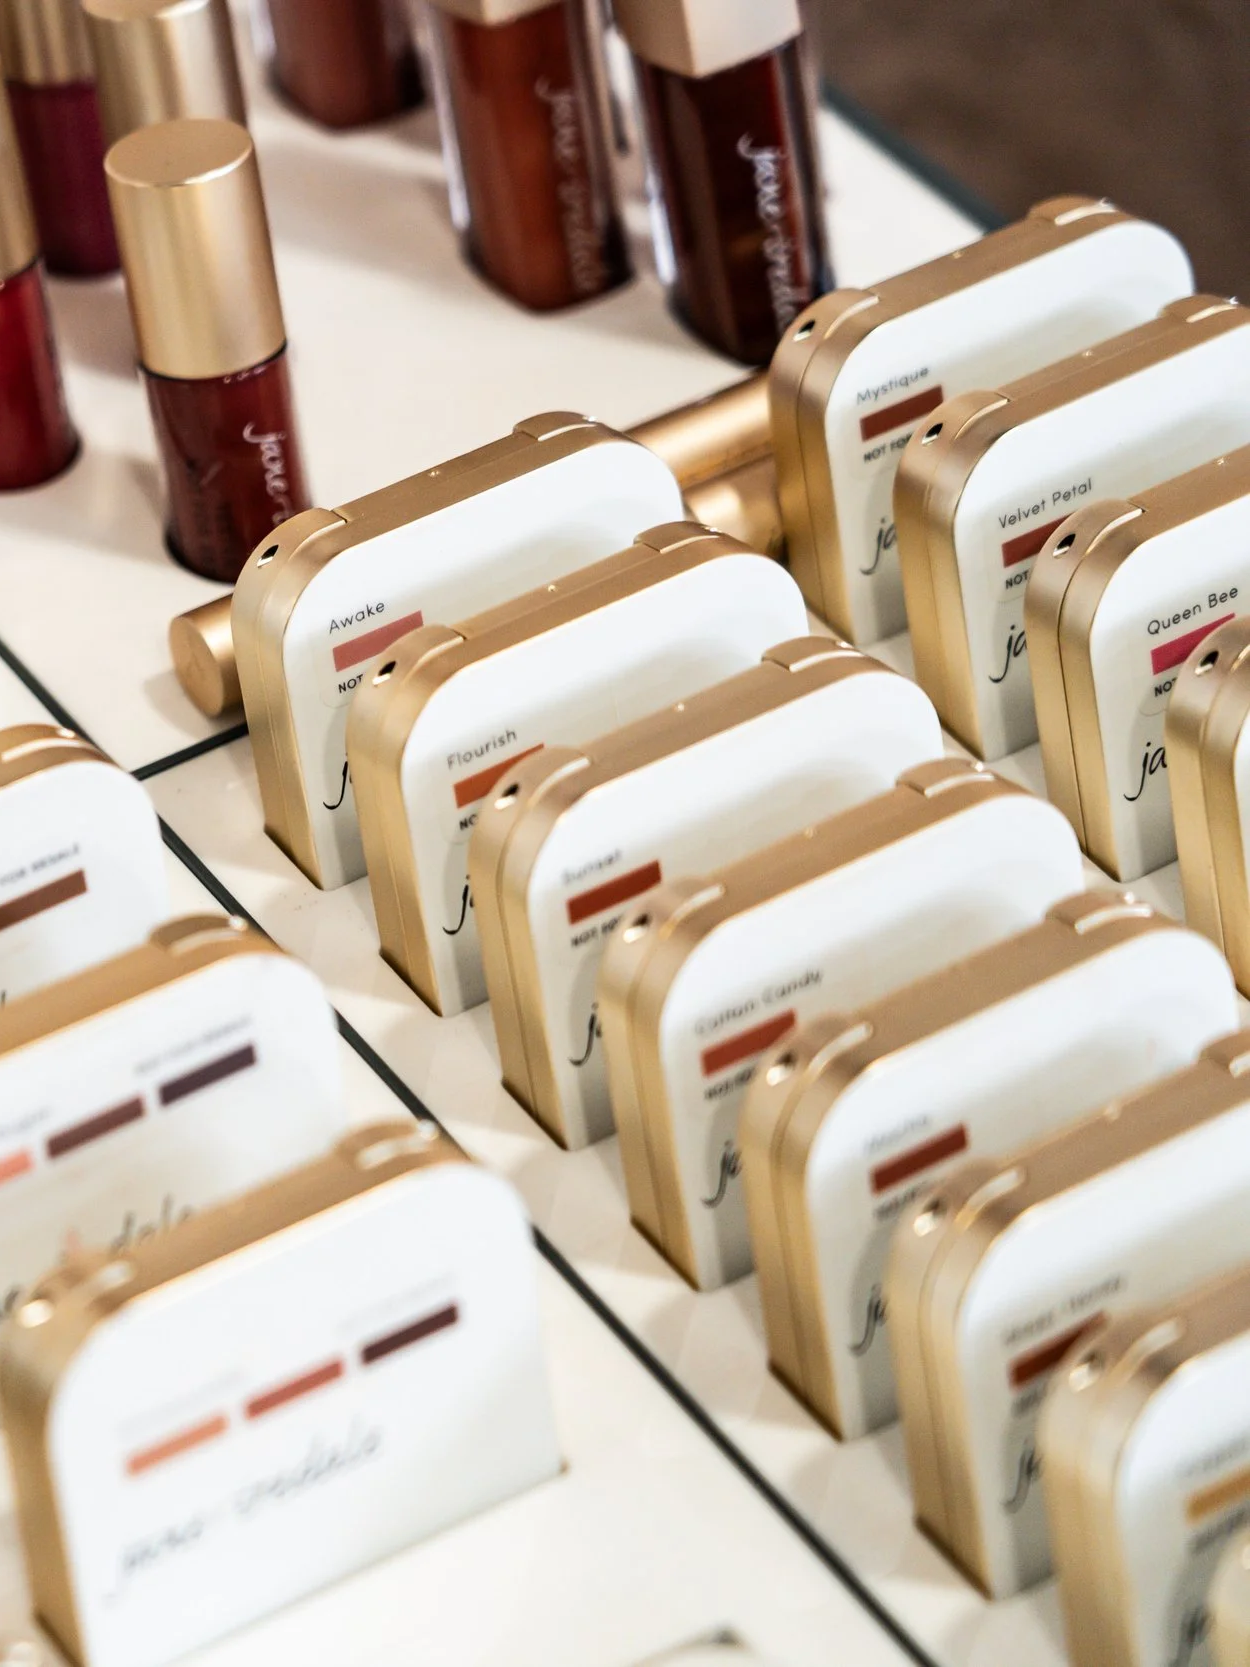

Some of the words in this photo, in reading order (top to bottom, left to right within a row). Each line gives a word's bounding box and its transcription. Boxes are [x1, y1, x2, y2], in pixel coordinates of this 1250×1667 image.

[856, 365, 930, 405] Mystique
[863, 438, 888, 464] NOT
[998, 498, 1047, 530] Velvet
[1051, 477, 1094, 507] Petal
[1005, 569, 1030, 591] NOT
[328, 600, 386, 635] Awake
[1146, 603, 1203, 636] Queen
[1207, 586, 1240, 610] Bee
[338, 673, 364, 695] NOT
[1154, 676, 1178, 698] NOT
[447, 728, 518, 771] Flourish
[762, 967, 824, 1004] Candy
